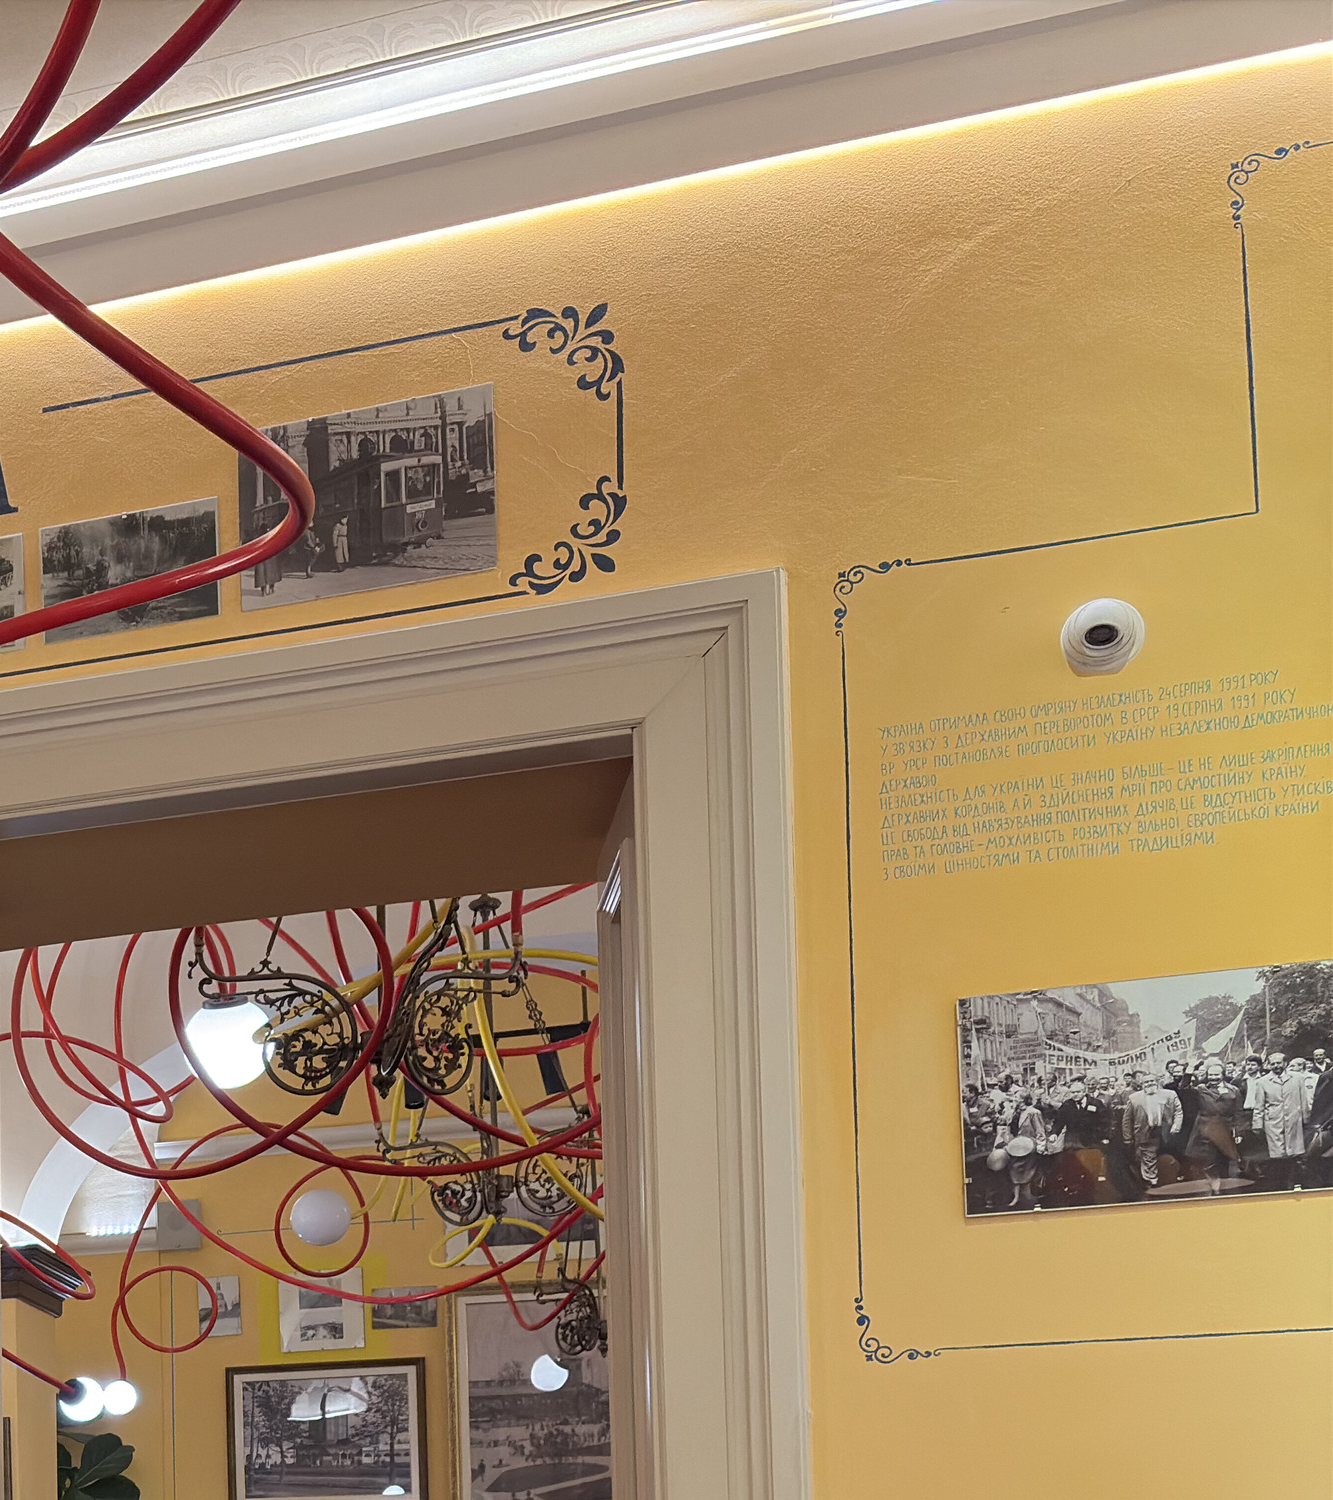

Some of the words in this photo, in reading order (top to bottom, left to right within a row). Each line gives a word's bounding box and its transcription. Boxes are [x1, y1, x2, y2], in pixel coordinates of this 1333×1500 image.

[880, 744, 889, 758] У
[955, 724, 1029, 749] ДЕРЖАВНИМ
[1034, 713, 1114, 737] ПЕРЕВОРОТОМ
[1120, 710, 1129, 725] В
[1132, 705, 1160, 724] СРСР
[1231, 693, 1256, 710] 1991
[1263, 688, 1297, 706] РОКУ
[929, 712, 989, 733] ОТРИМАЛА
[993, 707, 1026, 724] СВОЮ
[1030, 699, 1078, 719] ОМРІЯНУ
[1081, 689, 1154, 710] НЕЗАЛЕЖНІСТЬ
[903, 757, 928, 772] УРСР
[1017, 731, 1097, 757] ПРОГОЛОСИТИ
[1103, 724, 1156, 746] УКРАЇНУ
[1160, 714, 1240, 738] НЕЗАЛЕЖНОЮ
[878, 774, 937, 796] ДЕРЖАВОЮ
[879, 787, 959, 811] НЕЗАЛЕЖНІСТЬ
[962, 784, 987, 802] ДЛЯ
[1050, 773, 1065, 791] ЦЕ
[1071, 767, 1115, 787] ЗНАЧНО
[1122, 762, 1165, 782] БІЛЬШЕ
[1178, 758, 1194, 776] ЦЕ
[1199, 756, 1213, 772] НЕ
[1219, 751, 1256, 770] ЛИШЕ
[1260, 742, 1331, 764] ЗАКРІПЛЕННЯ
[880, 807, 948, 831] ДЕРЖАВНИХ
[1150, 778, 1173, 796] ПРО
[1177, 769, 1254, 792] САМОСТІЙНУ
[1261, 763, 1307, 783] КРАЇНУ
[882, 848, 910, 863] ПРАВ
[913, 845, 927, 860] ТА
[1072, 820, 1132, 842] РОЗВИТКУ
[901, 824, 948, 843] СВОБОДА
[952, 823, 971, 839] ВІД
[1055, 804, 1129, 826] ПОЛІТИЧНИХ
[1203, 786, 1276, 810] ВІДСУТНІСТЬ
[944, 852, 1021, 875] ЦІННОСТЯМИ
[1028, 849, 1043, 864] ТА
